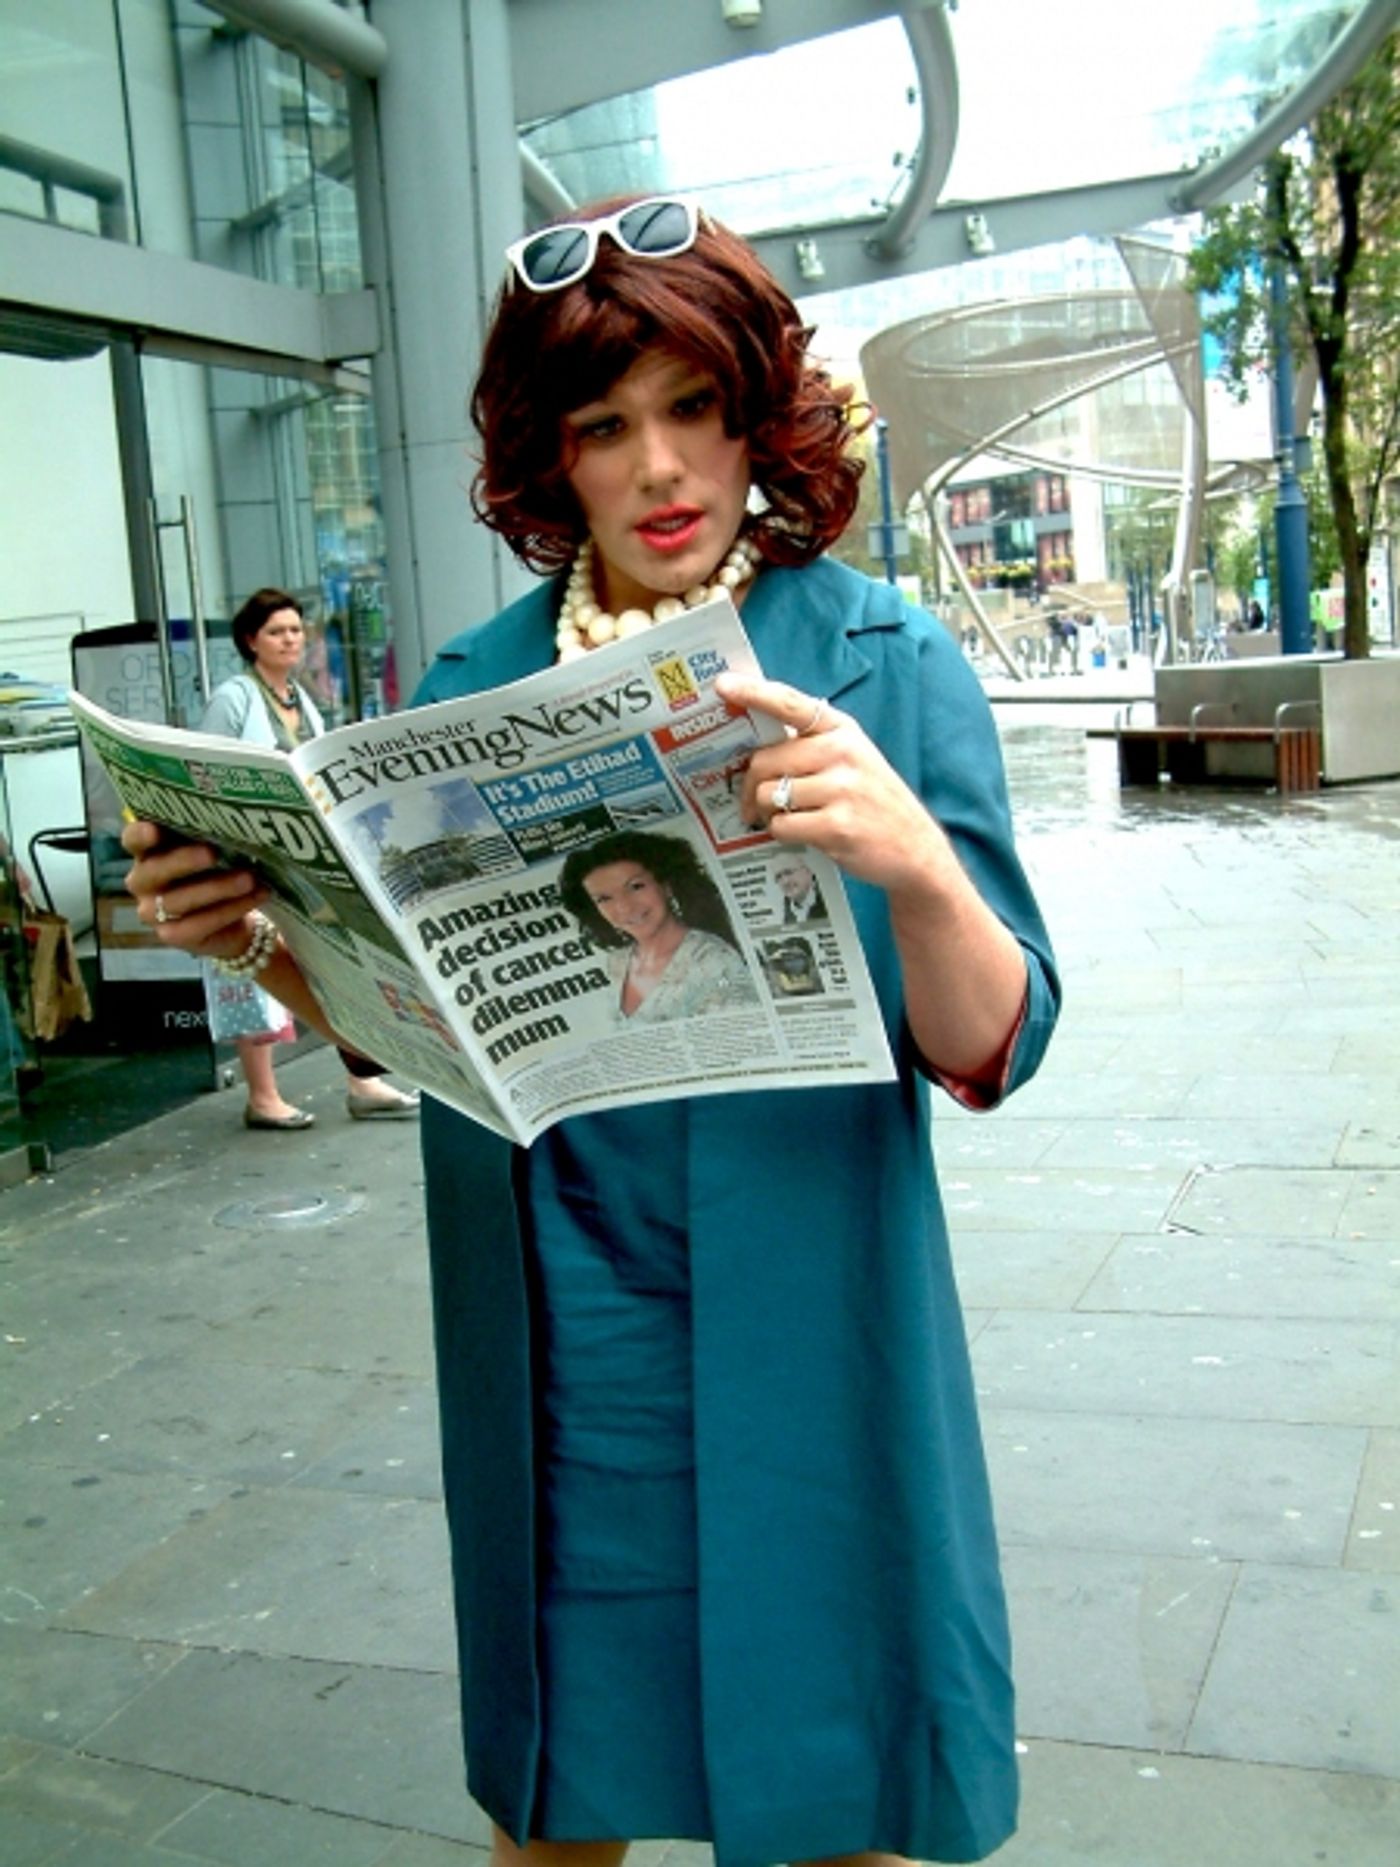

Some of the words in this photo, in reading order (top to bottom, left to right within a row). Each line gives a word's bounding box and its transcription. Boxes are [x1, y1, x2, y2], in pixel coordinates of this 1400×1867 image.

[350, 718, 478, 763] Manchester
[484, 780, 523, 804] It's
[521, 770, 567, 794] The
[566, 741, 642, 780] Etihad
[497, 780, 599, 825] Stadium!
[417, 884, 563, 952] Amazing
[436, 911, 570, 979] decision
[454, 968, 489, 1007] of
[492, 936, 596, 987] cancer
[472, 966, 611, 1036] dilemma
[485, 1013, 570, 1065] mum
